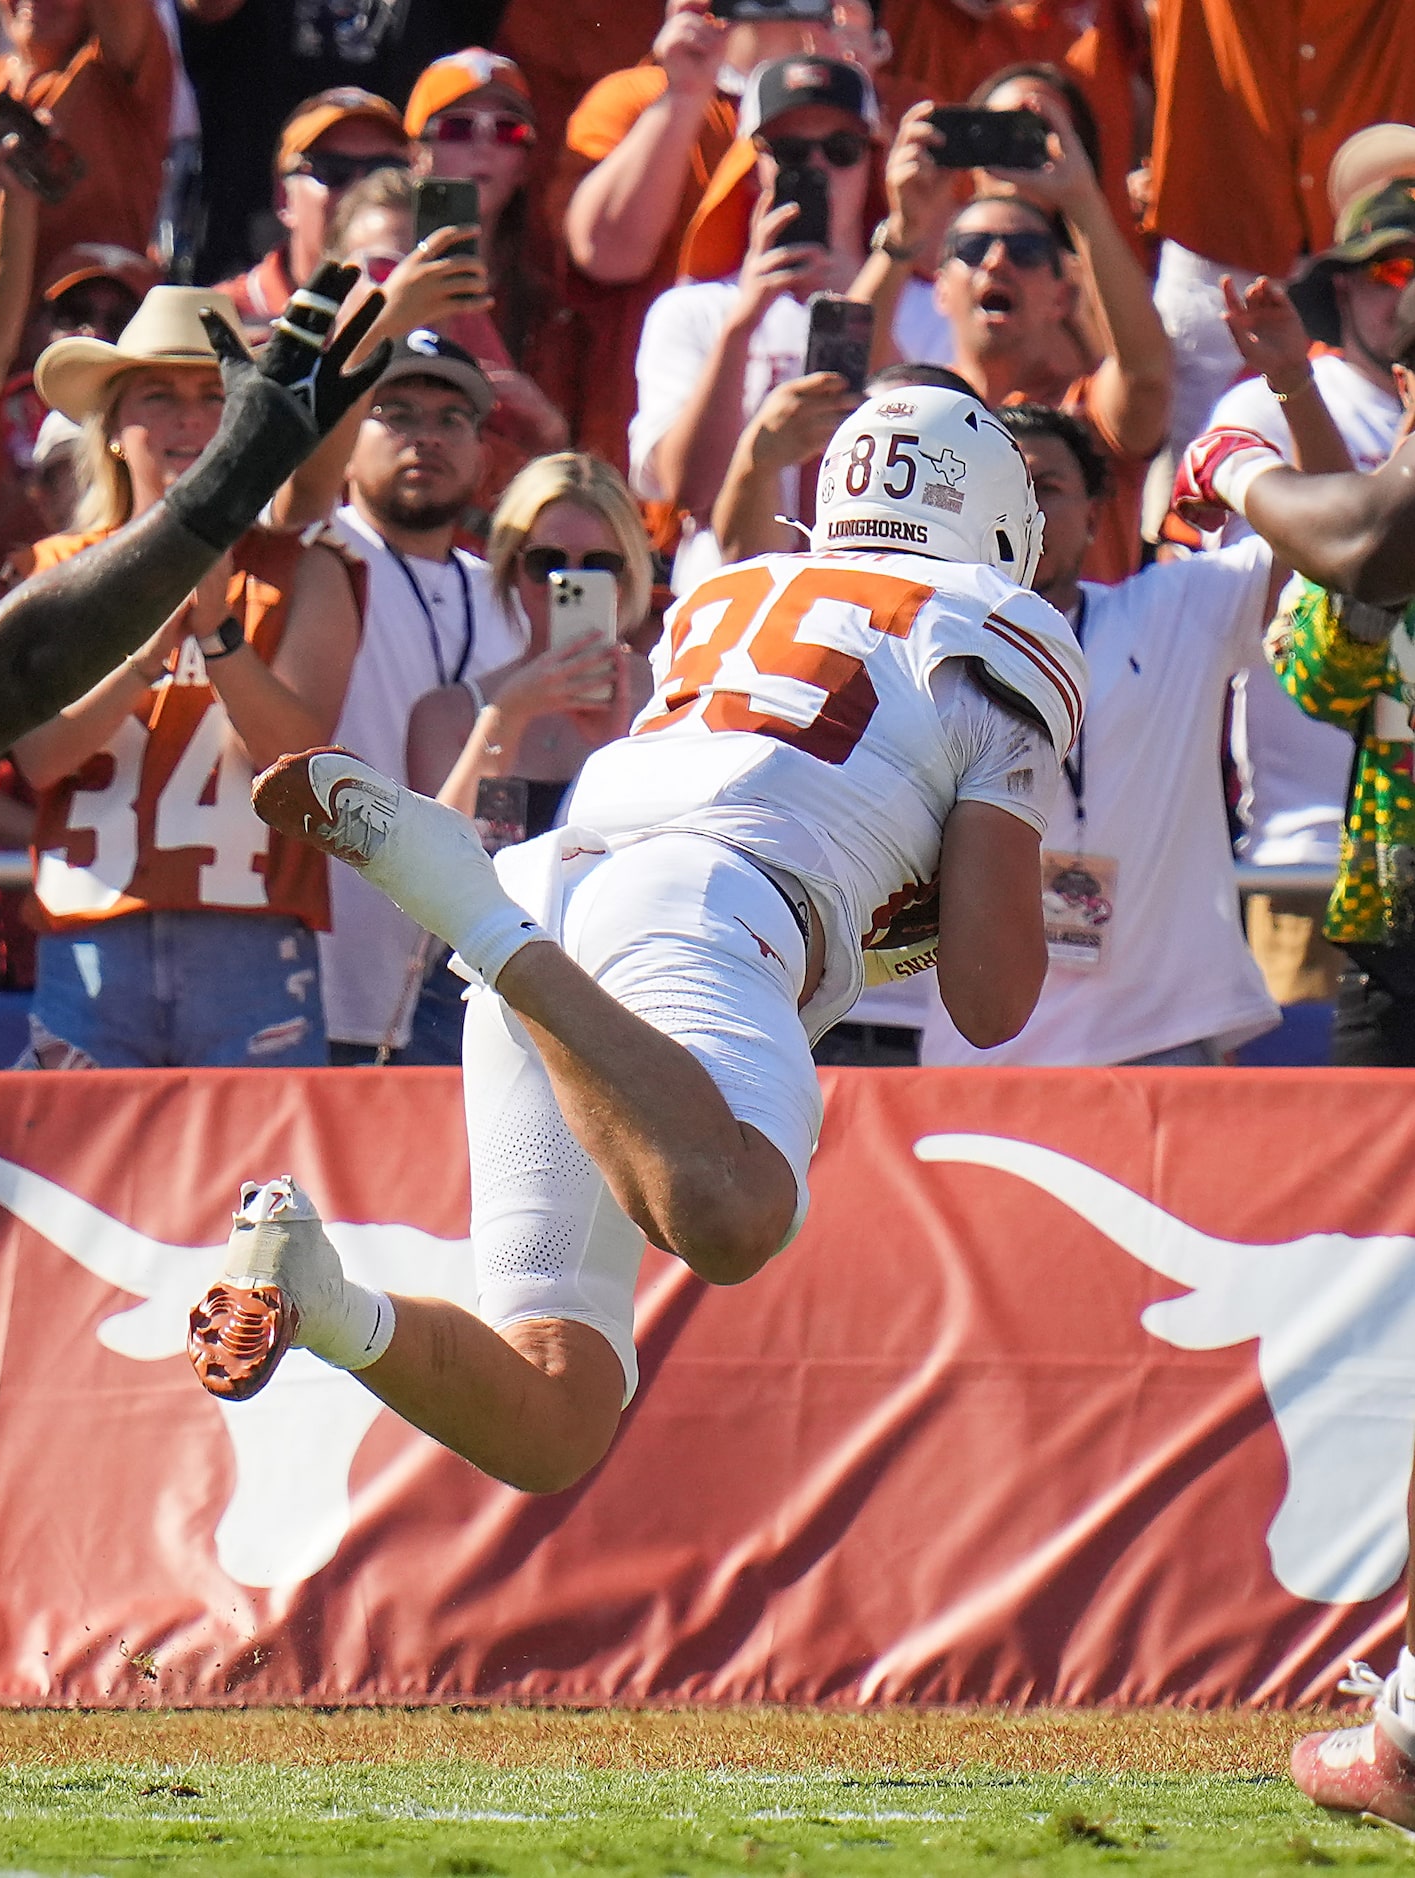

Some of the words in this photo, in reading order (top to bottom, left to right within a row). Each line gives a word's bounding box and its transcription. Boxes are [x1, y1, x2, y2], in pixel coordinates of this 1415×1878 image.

[846, 434, 920, 499] 85
[828, 519, 928, 544] LONGHORNS
[36, 702, 270, 917] 34
